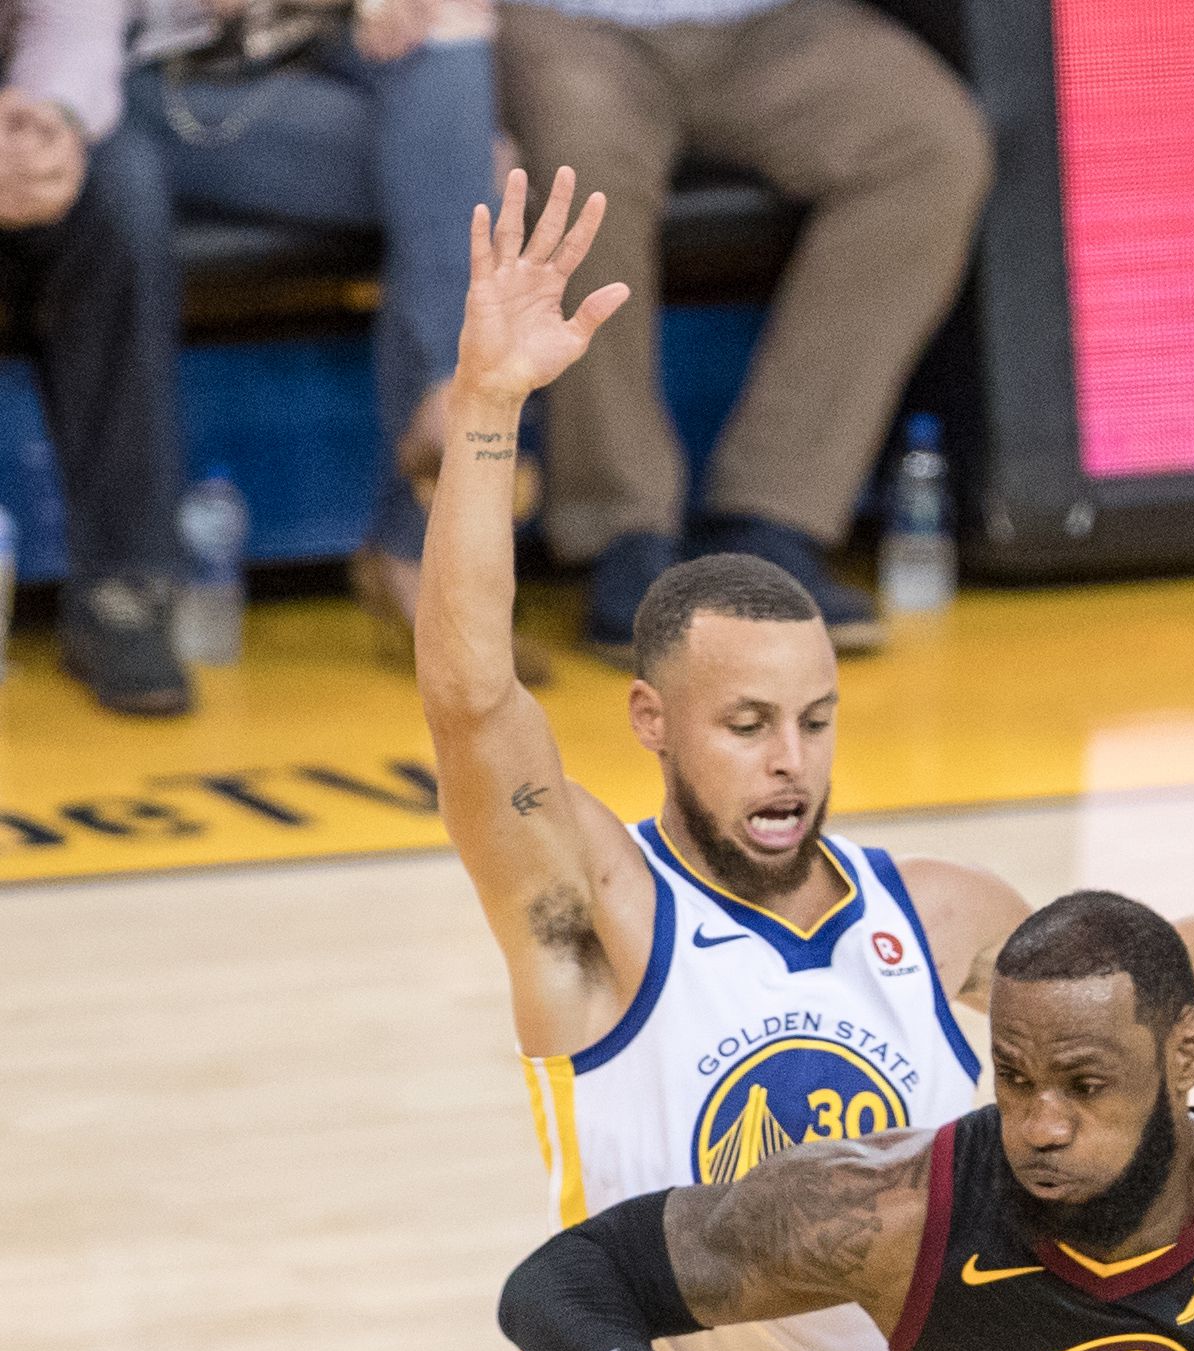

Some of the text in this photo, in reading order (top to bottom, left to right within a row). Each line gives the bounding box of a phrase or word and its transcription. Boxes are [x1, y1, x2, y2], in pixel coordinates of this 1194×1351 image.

[698, 1011, 920, 1093] GOLDEN STATE
[802, 1088, 888, 1143] 30
